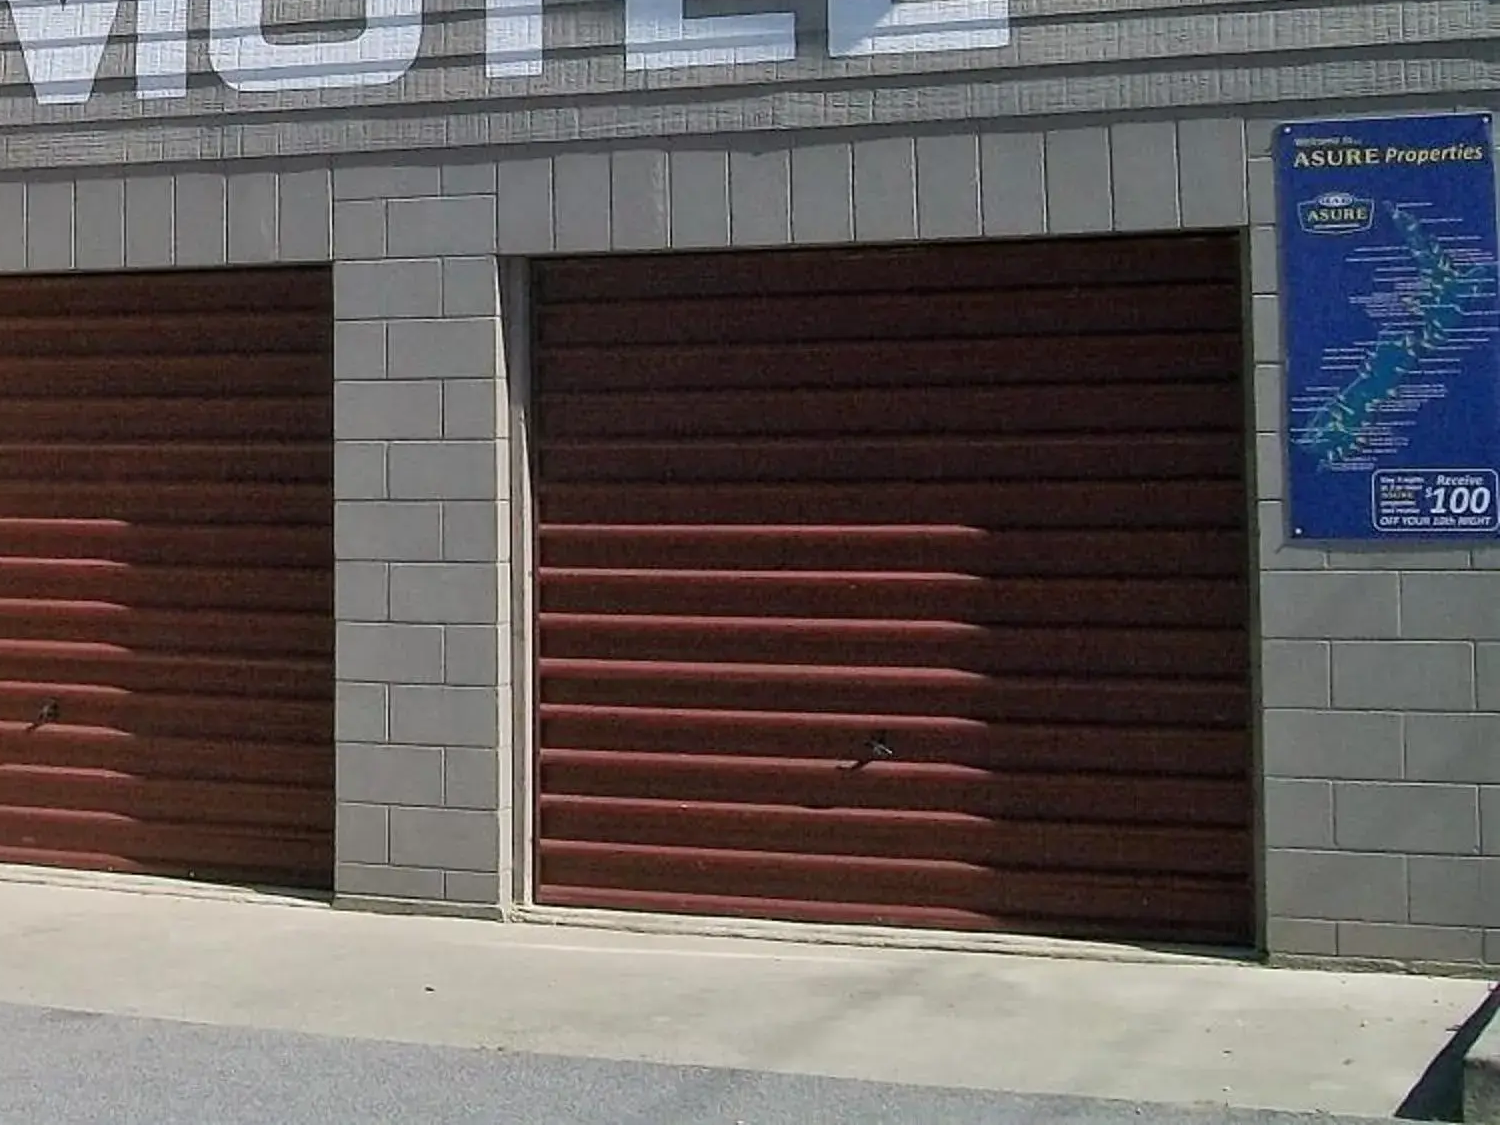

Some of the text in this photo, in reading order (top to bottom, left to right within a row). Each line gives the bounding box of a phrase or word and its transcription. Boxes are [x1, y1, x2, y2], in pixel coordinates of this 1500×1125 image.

[1293, 143, 1484, 167] ASURE Properties
[1308, 207, 1368, 222] ASURE
[1437, 474, 1484, 486] Receive
[1425, 486, 1491, 514] $100
[1379, 516, 1399, 526] OFF
[1402, 516, 1431, 526] YOUR
